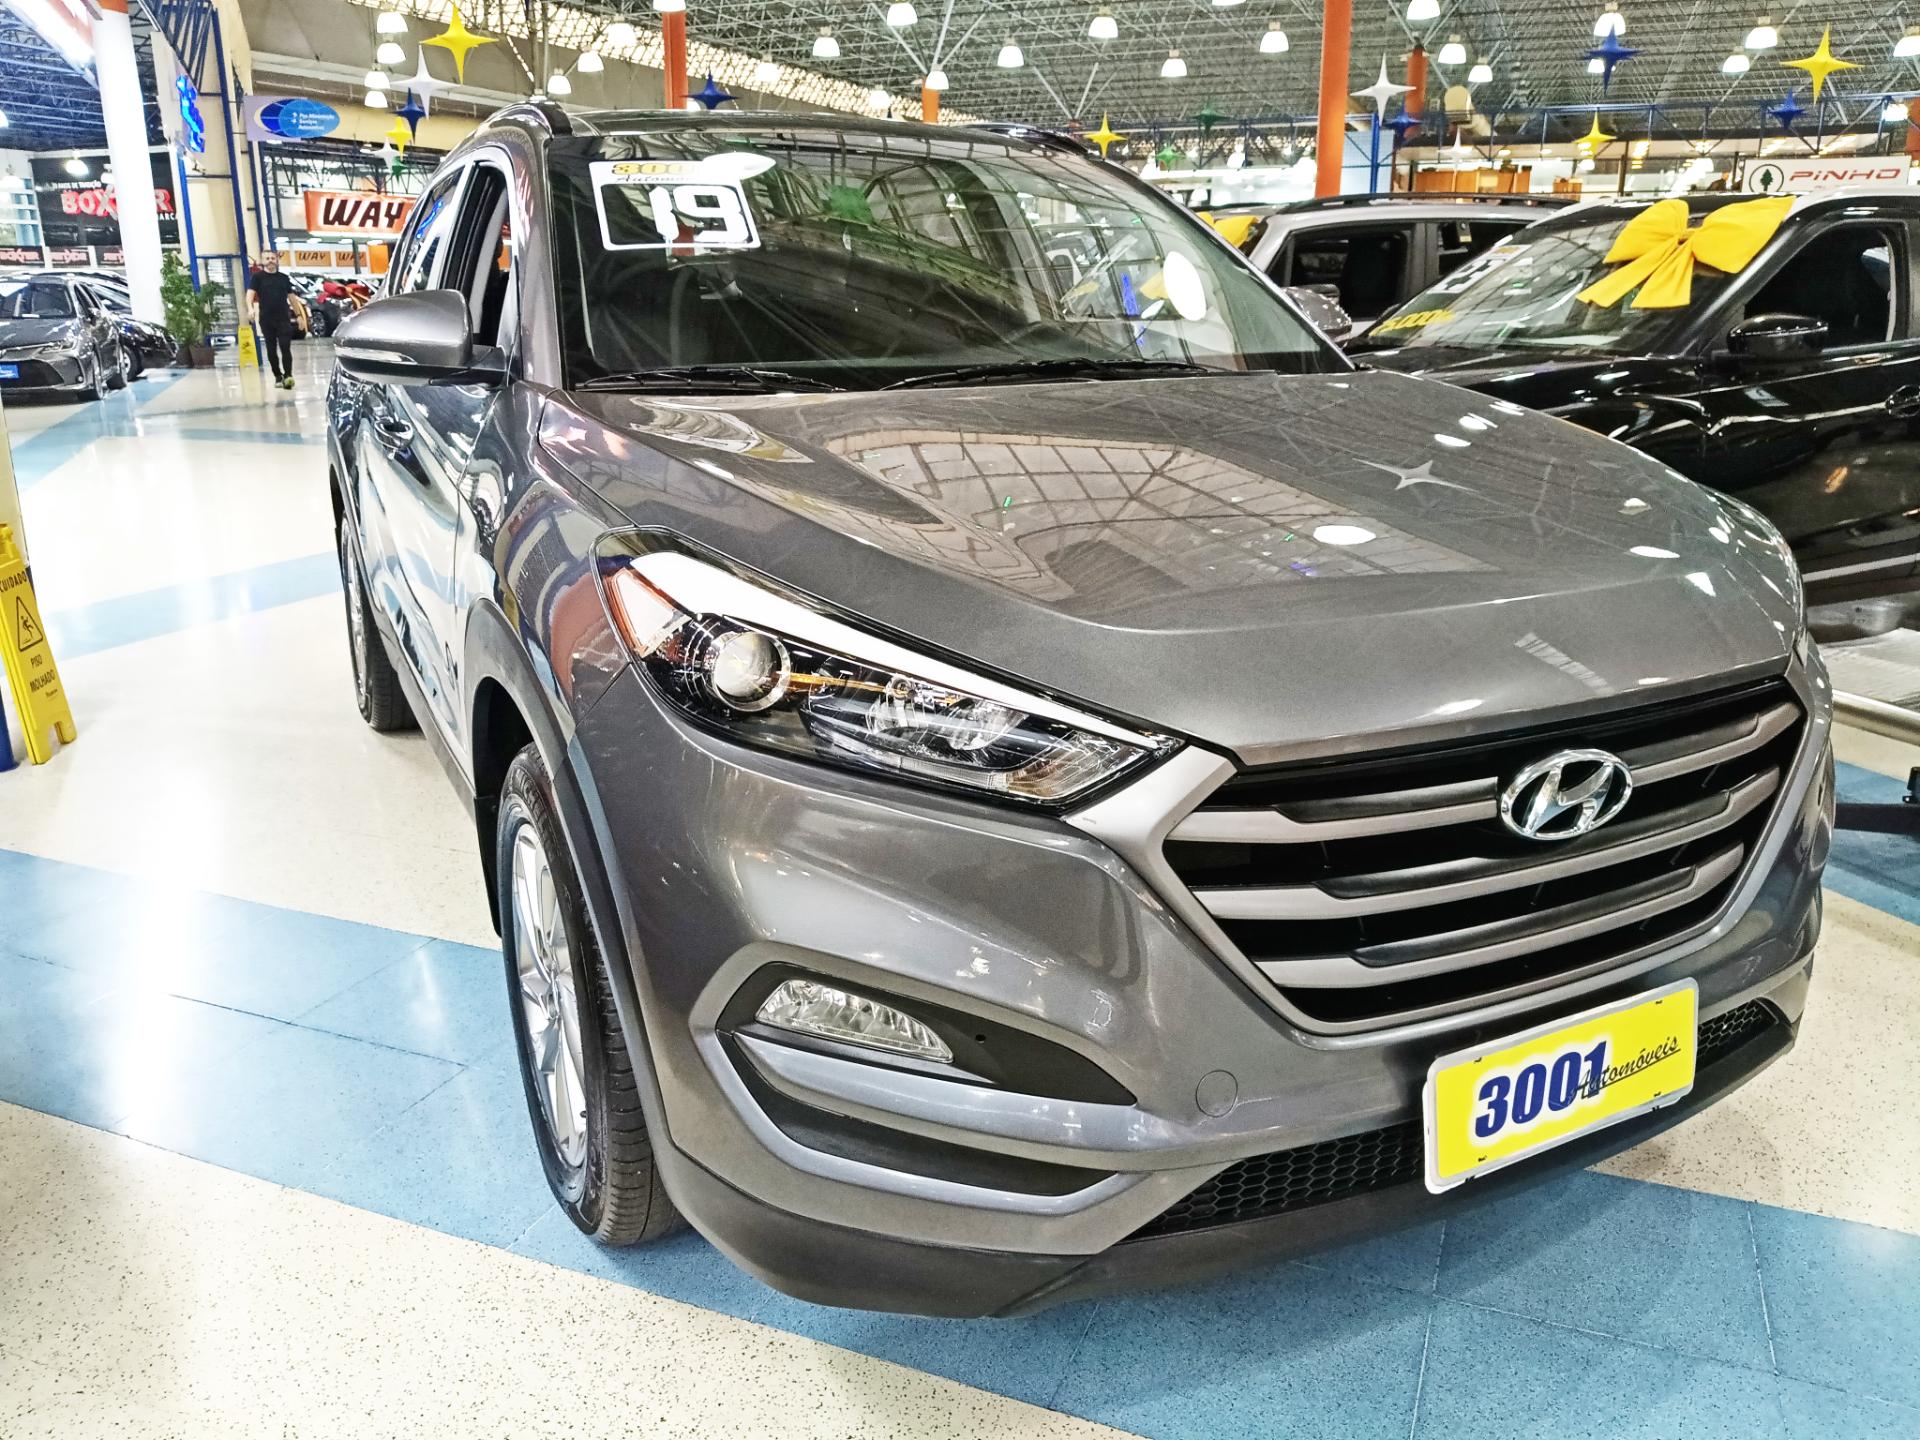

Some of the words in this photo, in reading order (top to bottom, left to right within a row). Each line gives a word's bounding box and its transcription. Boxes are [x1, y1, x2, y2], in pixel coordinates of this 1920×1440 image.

[323, 198, 405, 229] WAY
[648, 186, 750, 243] 19
[298, 250, 326, 261] WAY
[30, 653, 43, 669] PISO
[29, 668, 56, 693] MOLHADO
[1475, 1041, 1606, 1138] 3001
[1567, 1035, 1681, 1100] Automóveis
